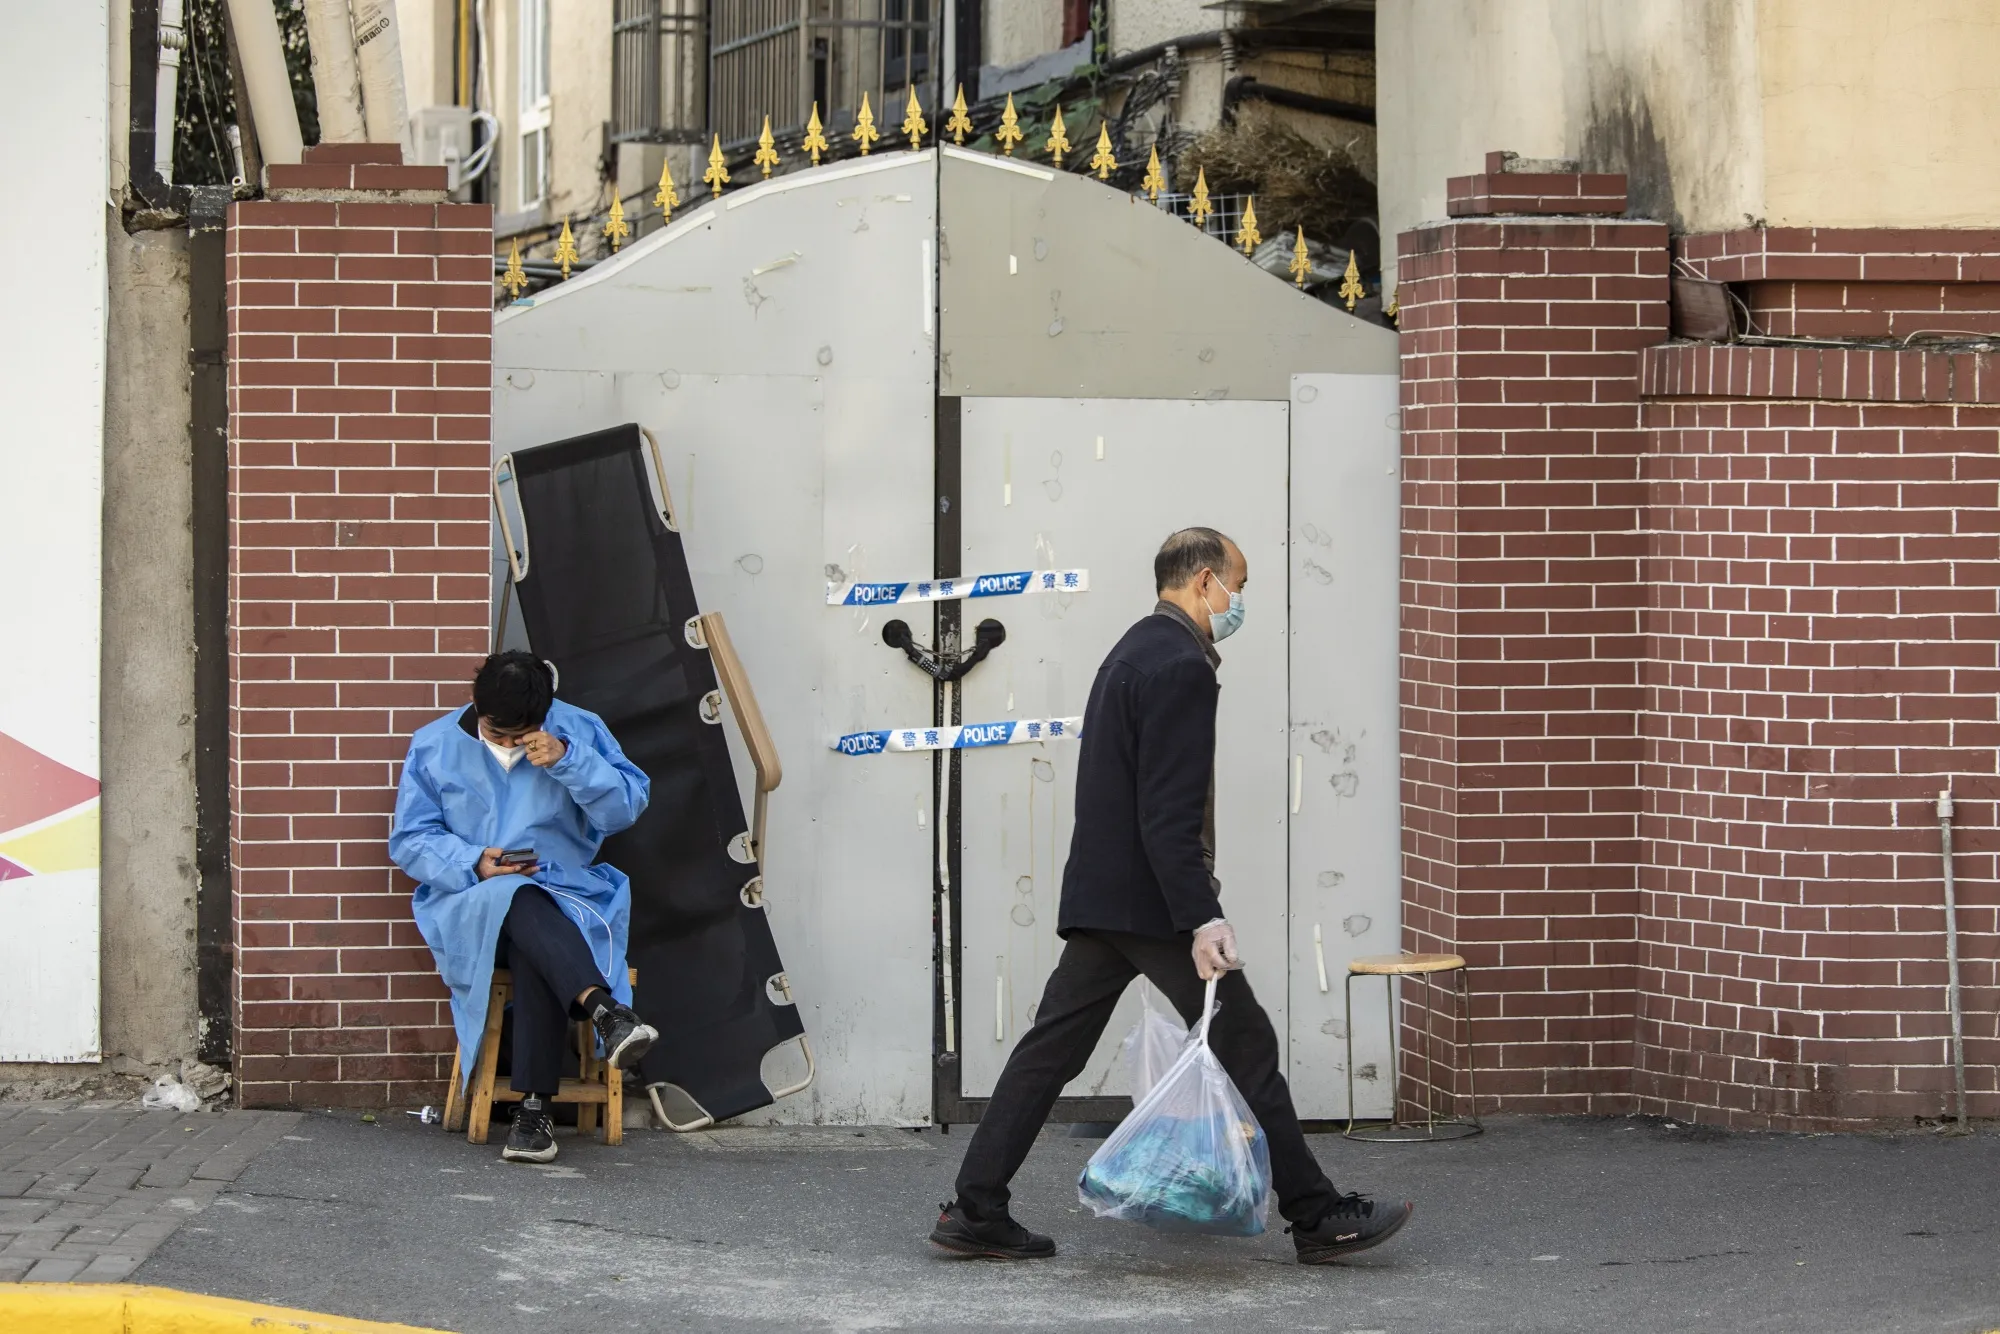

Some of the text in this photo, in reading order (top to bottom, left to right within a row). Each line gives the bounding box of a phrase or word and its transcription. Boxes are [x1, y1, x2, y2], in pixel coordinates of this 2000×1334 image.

[917, 581, 954, 598] 警察
[980, 575, 1022, 593] POLICE
[1042, 572, 1079, 589] 警察
[854, 586, 897, 602] POLICE
[963, 725, 1007, 743] POLICE
[1027, 720, 1064, 739] 警察
[841, 734, 882, 753] POLICE
[902, 730, 939, 748] 警察
